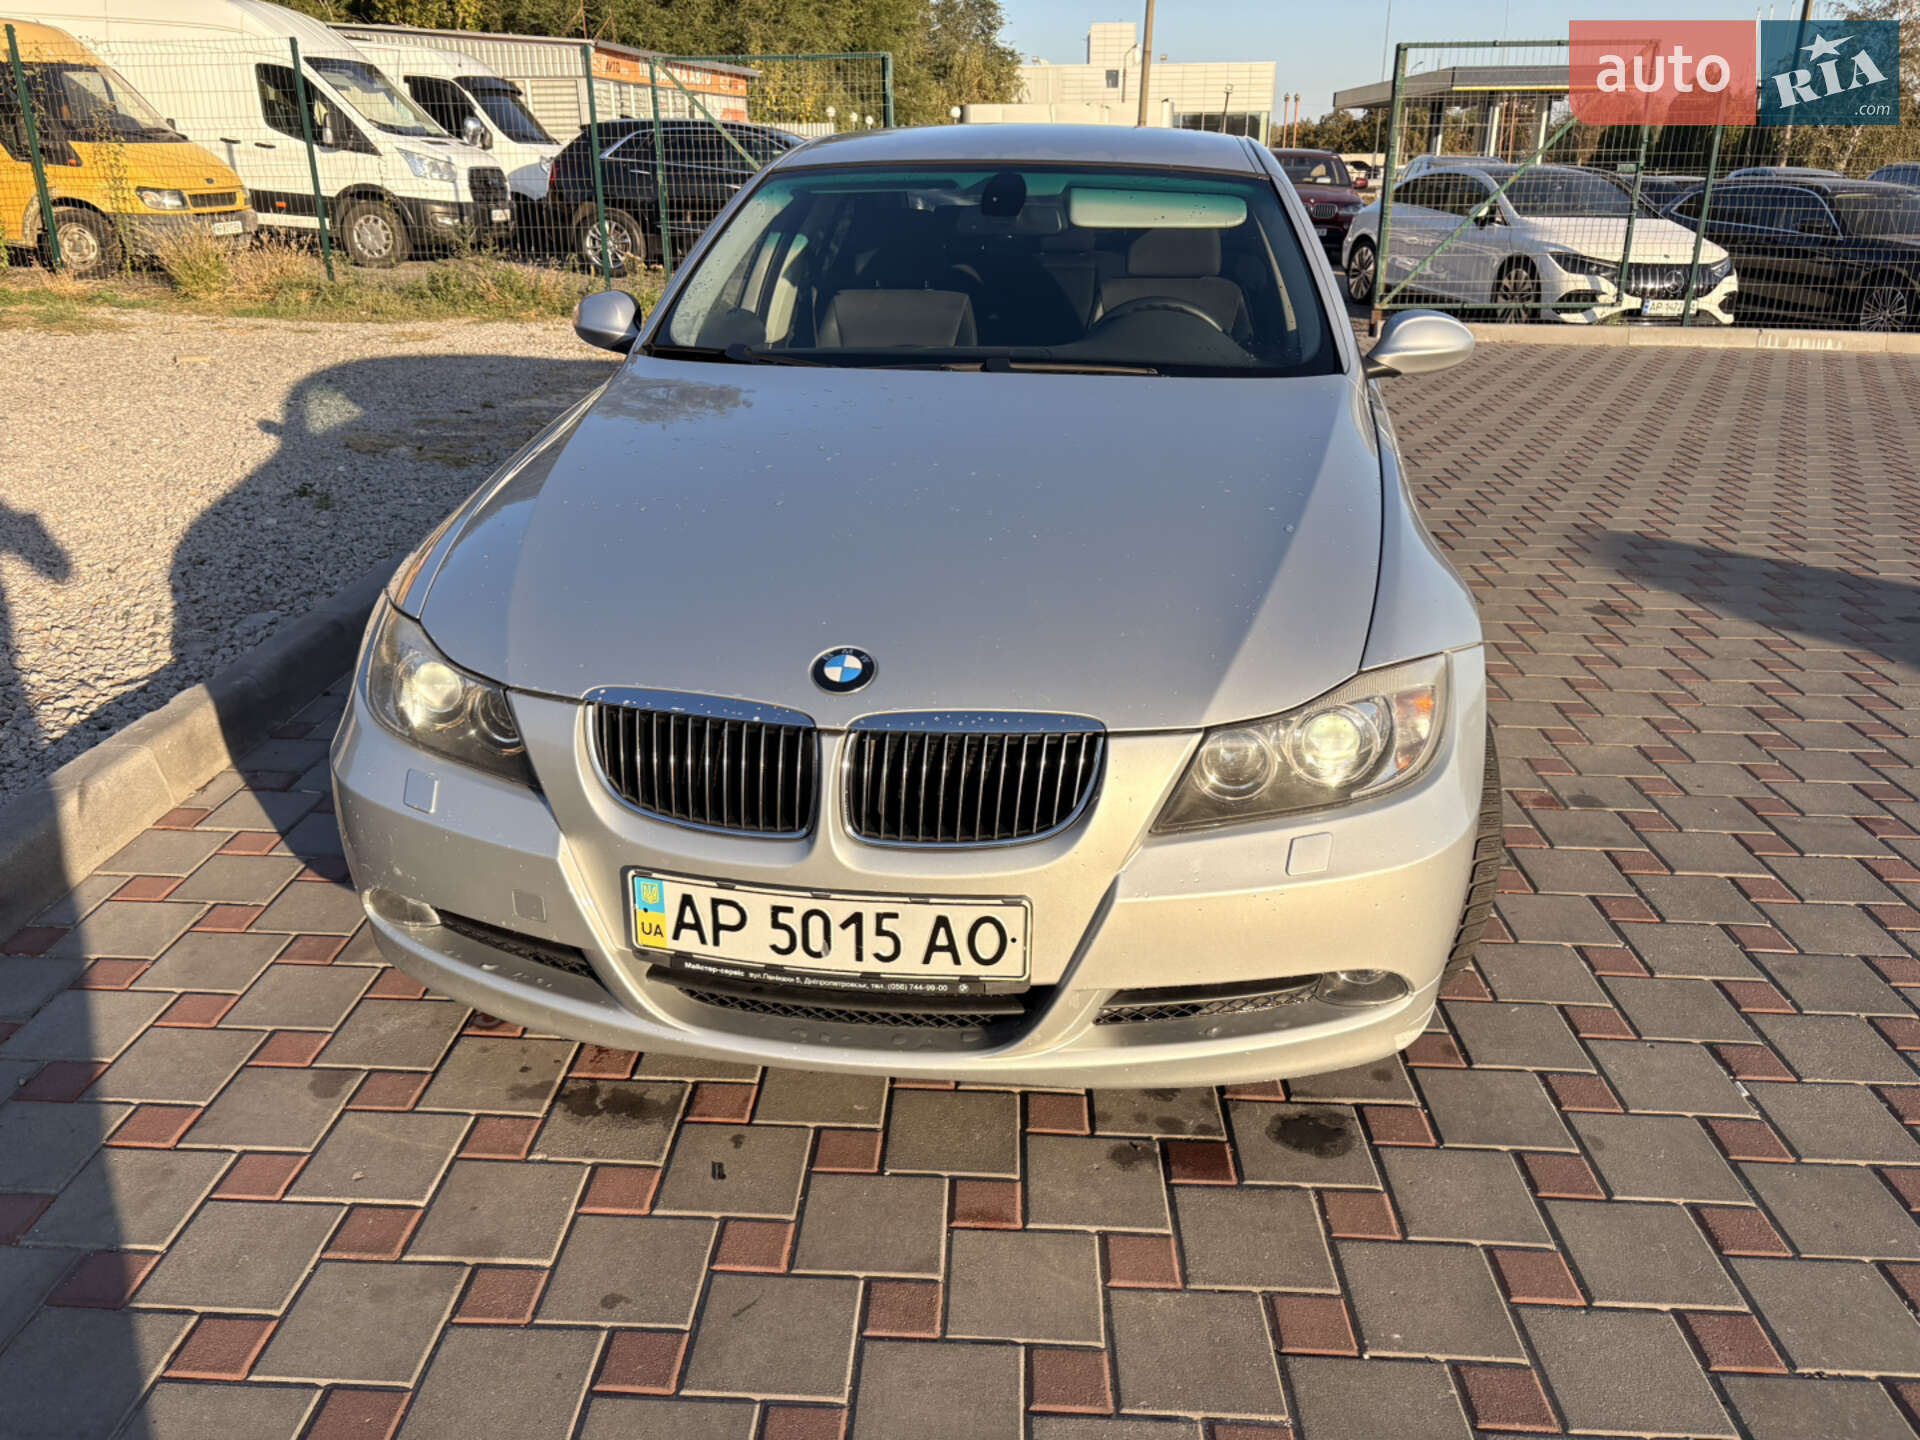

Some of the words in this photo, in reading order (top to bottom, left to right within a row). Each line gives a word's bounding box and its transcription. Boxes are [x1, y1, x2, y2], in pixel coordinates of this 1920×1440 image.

[641, 921, 664, 938] UA
[672, 893, 747, 947] AP
[769, 904, 901, 963] 5015
[922, 914, 1008, 966] AO
